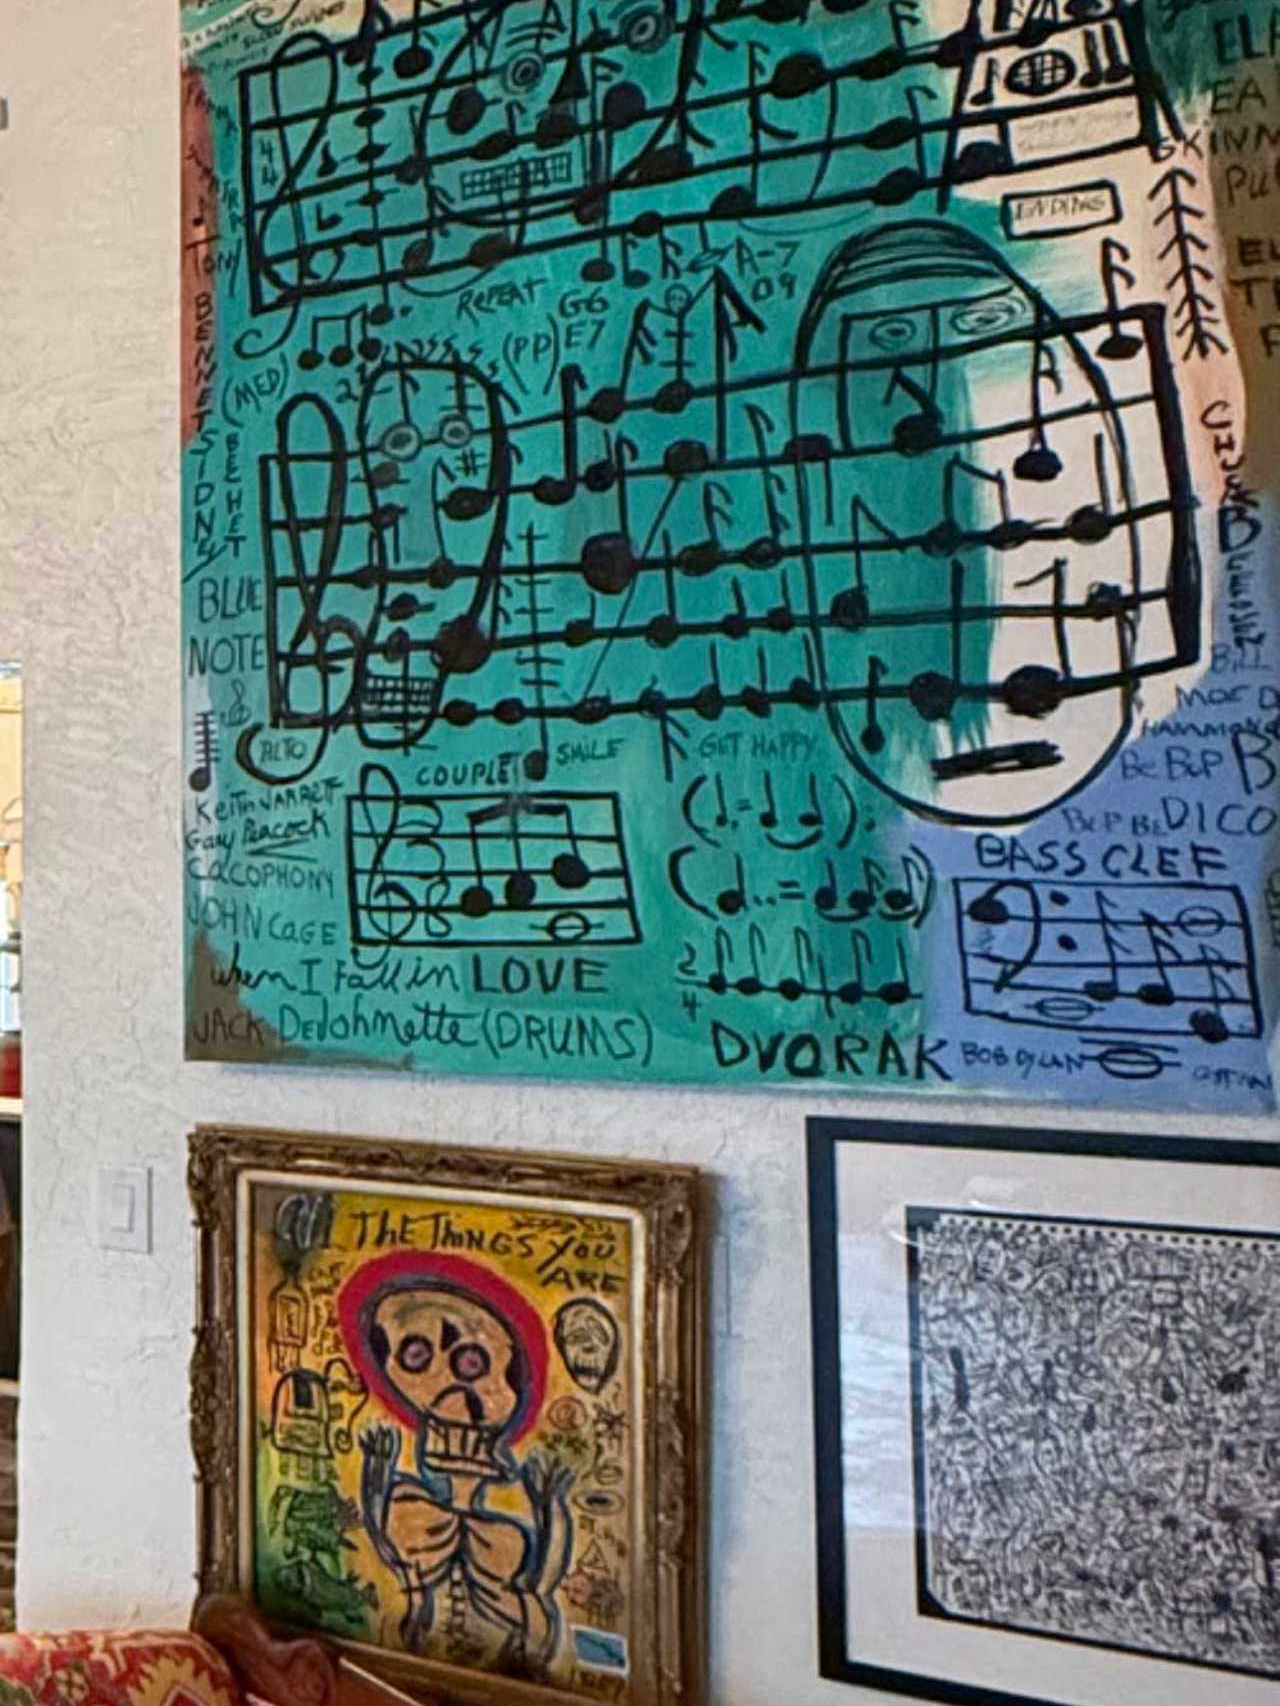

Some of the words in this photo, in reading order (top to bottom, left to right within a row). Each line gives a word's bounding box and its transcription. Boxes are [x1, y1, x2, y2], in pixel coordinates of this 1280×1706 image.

[559, 287, 610, 317] G6
[565, 320, 606, 351] E7
[197, 576, 265, 625] BLUE
[188, 632, 266, 679] NOTE
[260, 737, 308, 764] ALTO
[750, 731, 818, 759] HAPPY
[974, 833, 1088, 877] BASS
[1101, 842, 1228, 879] CLEF
[188, 896, 263, 942] JOHN
[299, 957, 323, 995] I
[472, 953, 610, 996] LOVE
[192, 1008, 264, 1045] JACK
[481, 1005, 655, 1070] (DRUMS)
[539, 1267, 630, 1296] ARE
